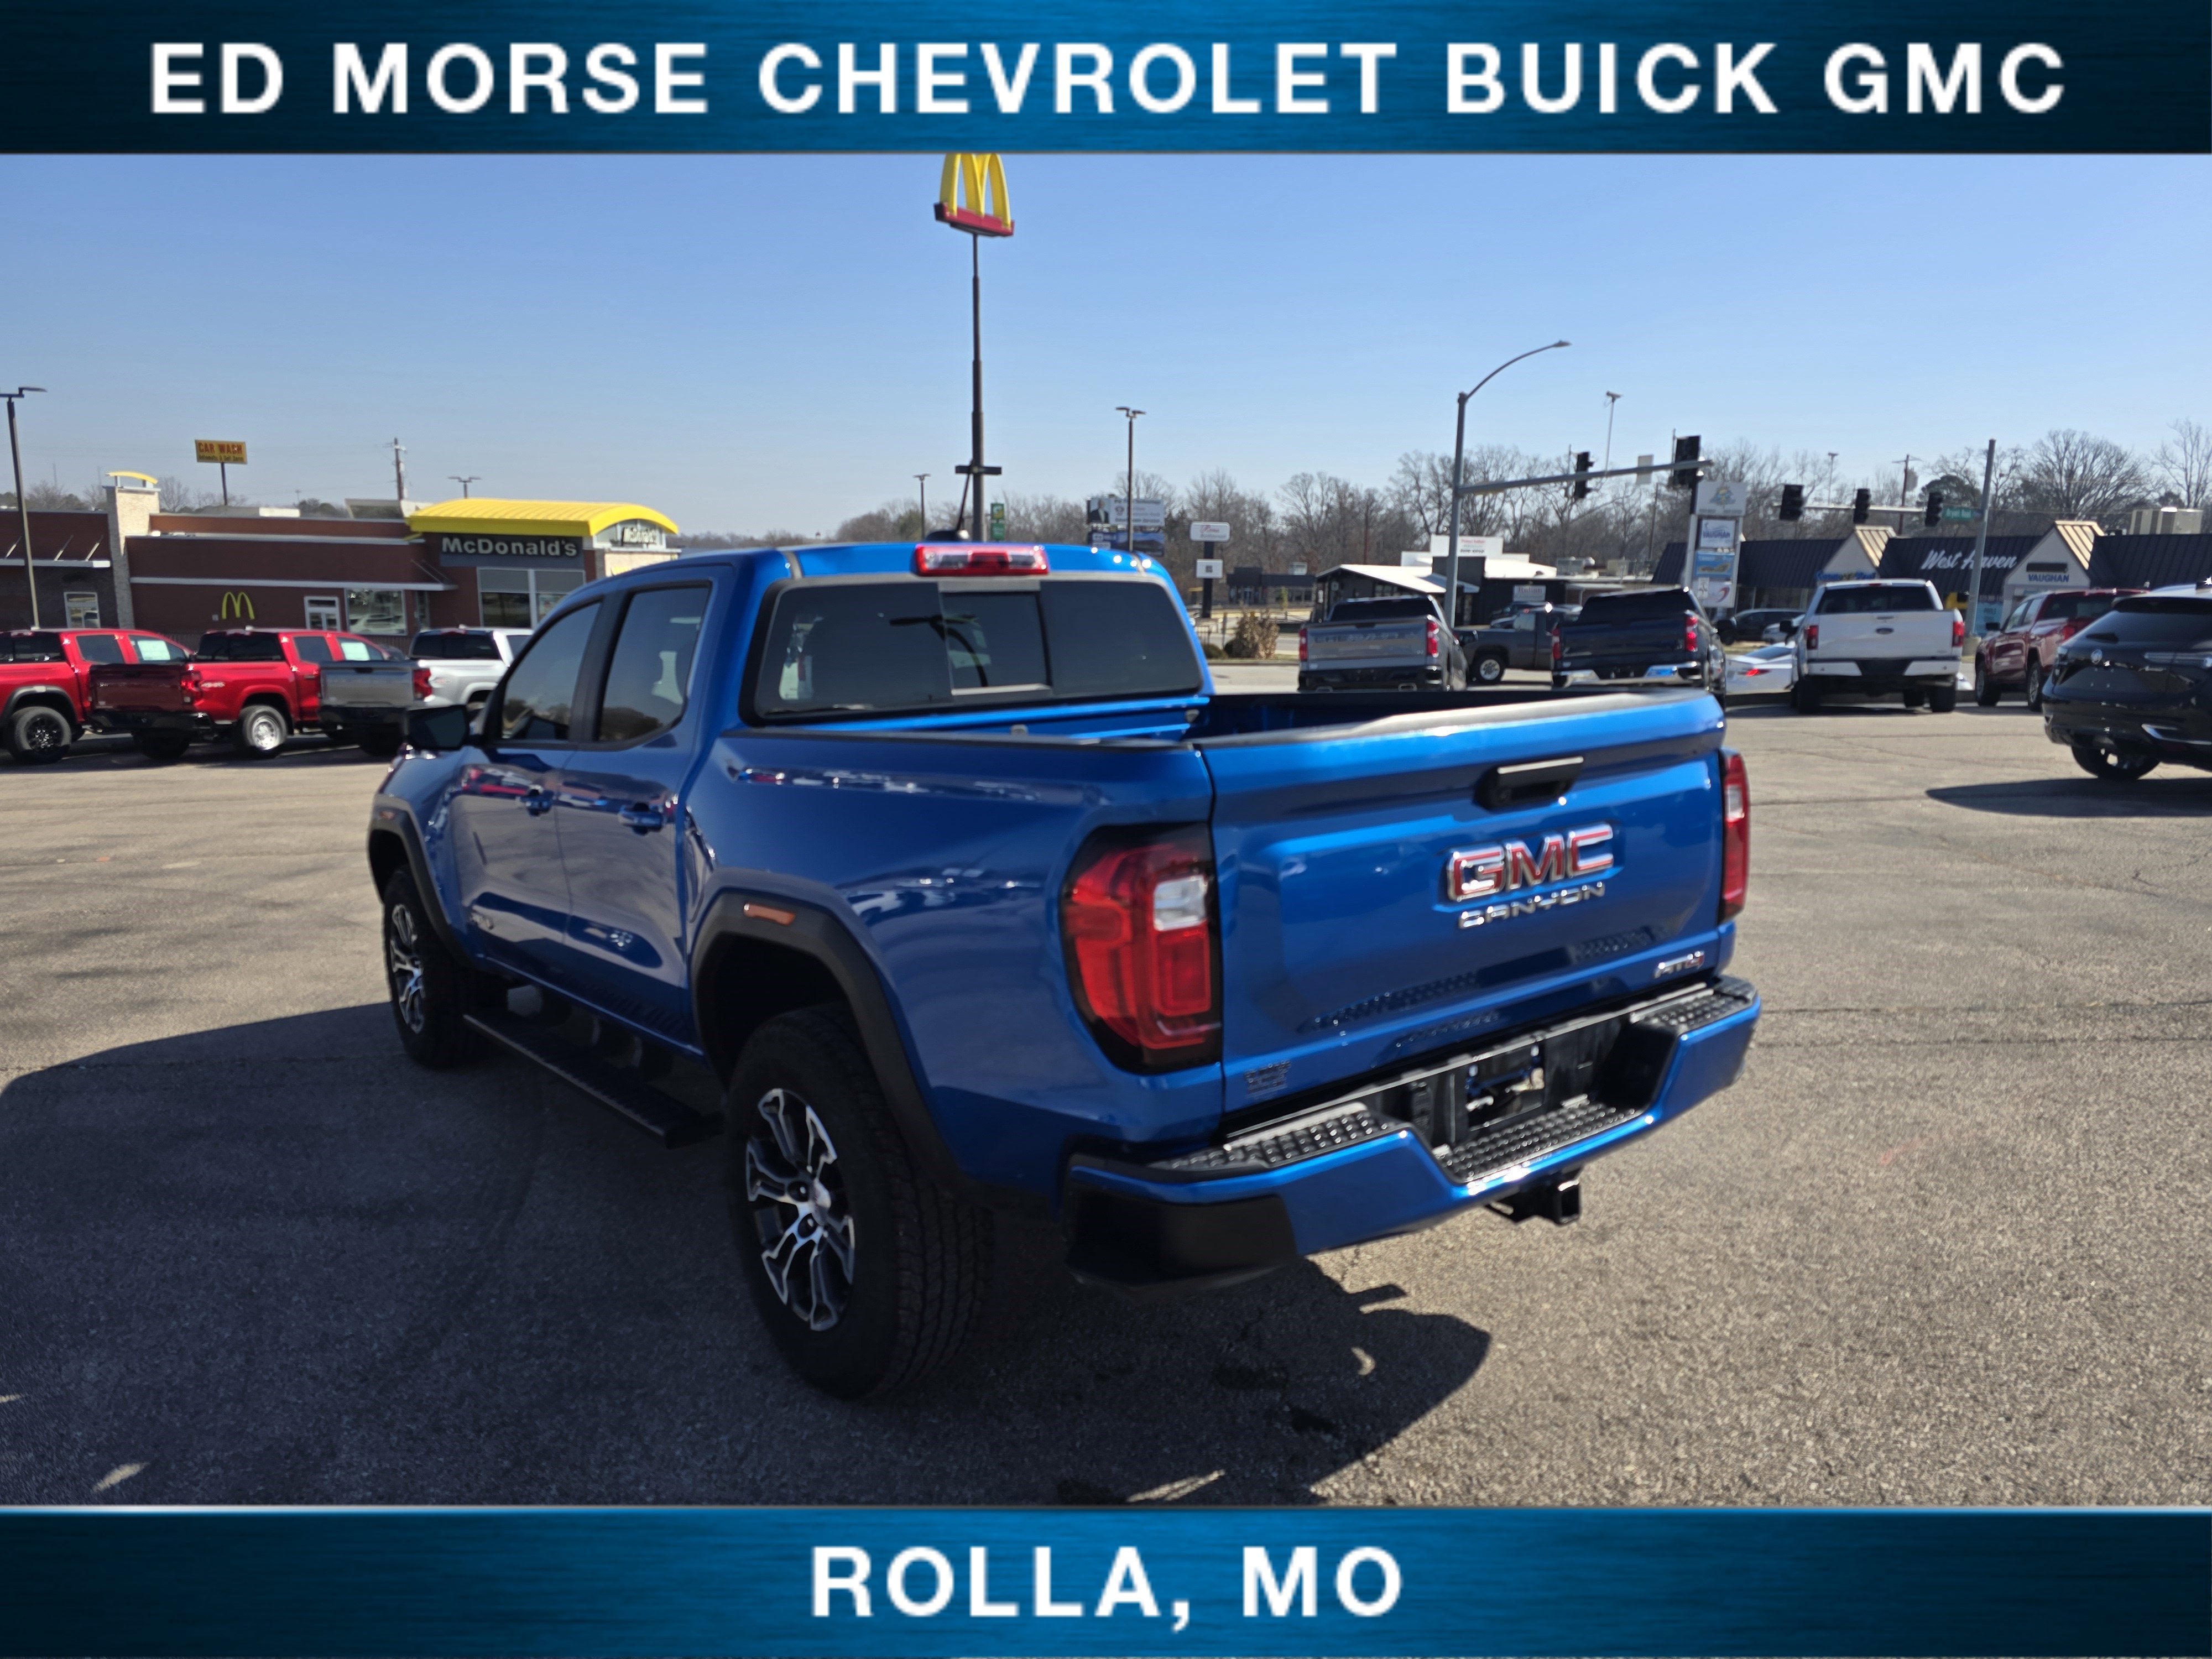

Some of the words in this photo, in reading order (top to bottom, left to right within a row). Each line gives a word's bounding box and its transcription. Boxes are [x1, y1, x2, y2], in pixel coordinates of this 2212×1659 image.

[198, 442, 215, 453] CAR
[218, 444, 242, 455] WASH
[442, 536, 577, 556] McDonald's
[1920, 549, 1962, 570] West
[2028, 573, 2070, 583] VAUGHAN
[1446, 823, 1614, 902] GMC
[1458, 881, 1605, 930] CANYON
